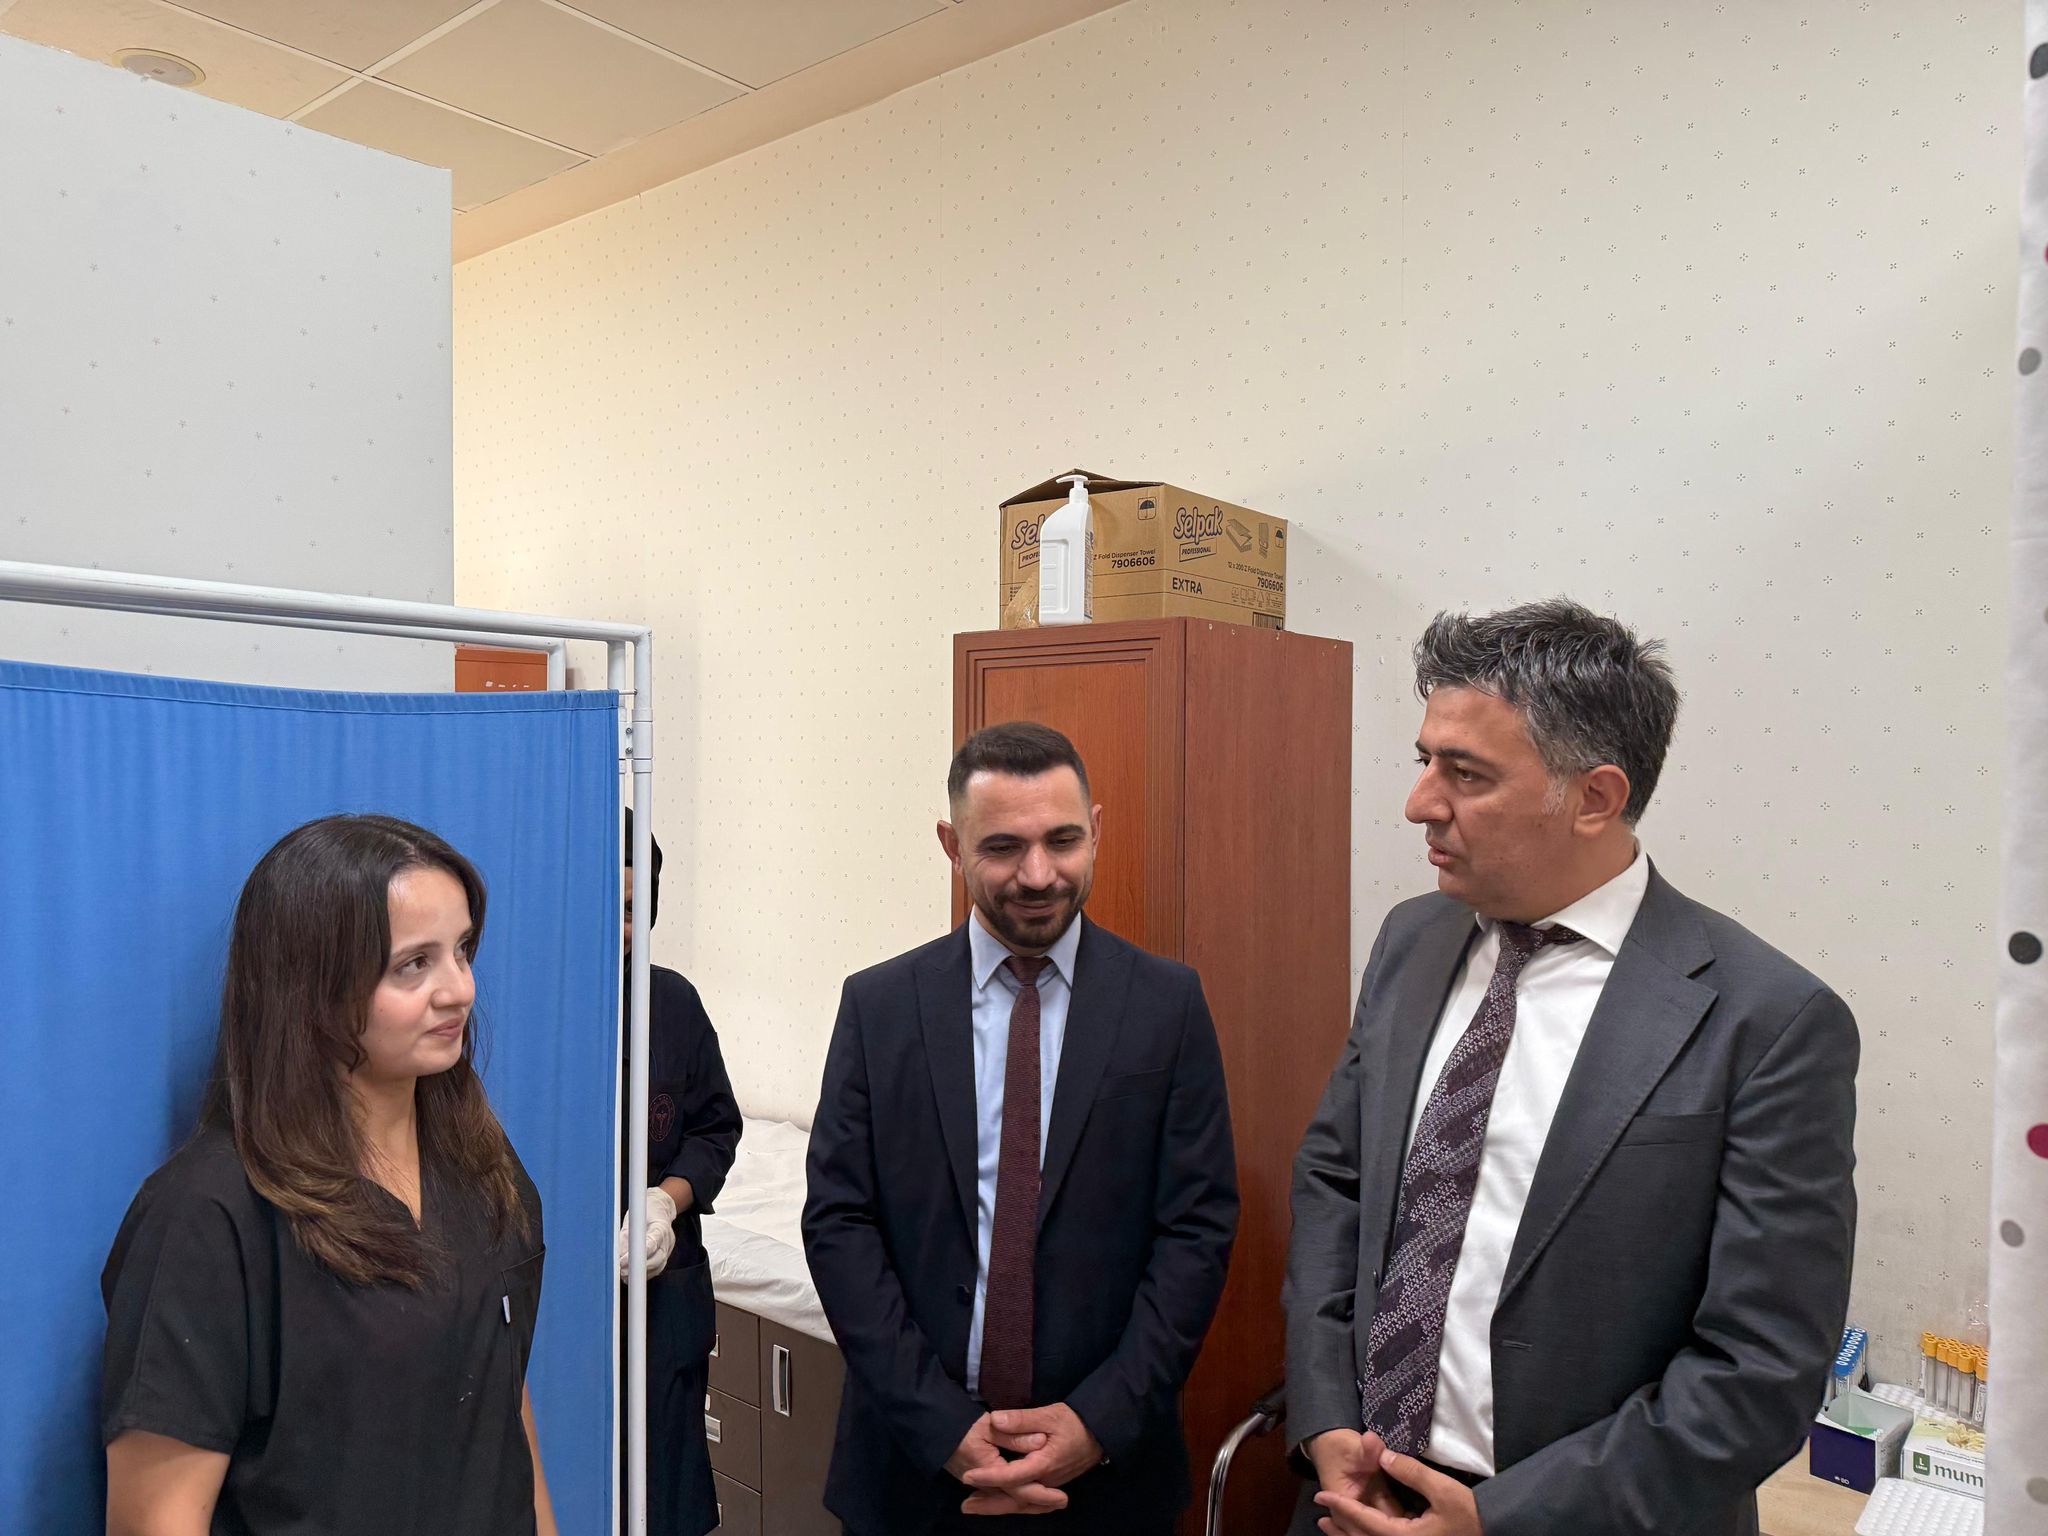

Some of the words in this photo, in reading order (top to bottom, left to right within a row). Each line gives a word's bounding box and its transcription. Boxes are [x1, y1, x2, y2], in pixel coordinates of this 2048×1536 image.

[1173, 505, 1223, 545] Selpak
[1098, 552, 1110, 560] Fold
[1111, 550, 1138, 559] Dispenser
[1140, 548, 1156, 556] Towel
[1182, 546, 1212, 555] PROFESSIONAL
[1111, 556, 1156, 569] 7906606
[1248, 566, 1256, 574] Fold
[1257, 568, 1274, 578] Dispenser
[1172, 577, 1203, 595] EXTRA
[1257, 576, 1284, 592] 7906606
[1919, 1457, 1925, 1466] L
